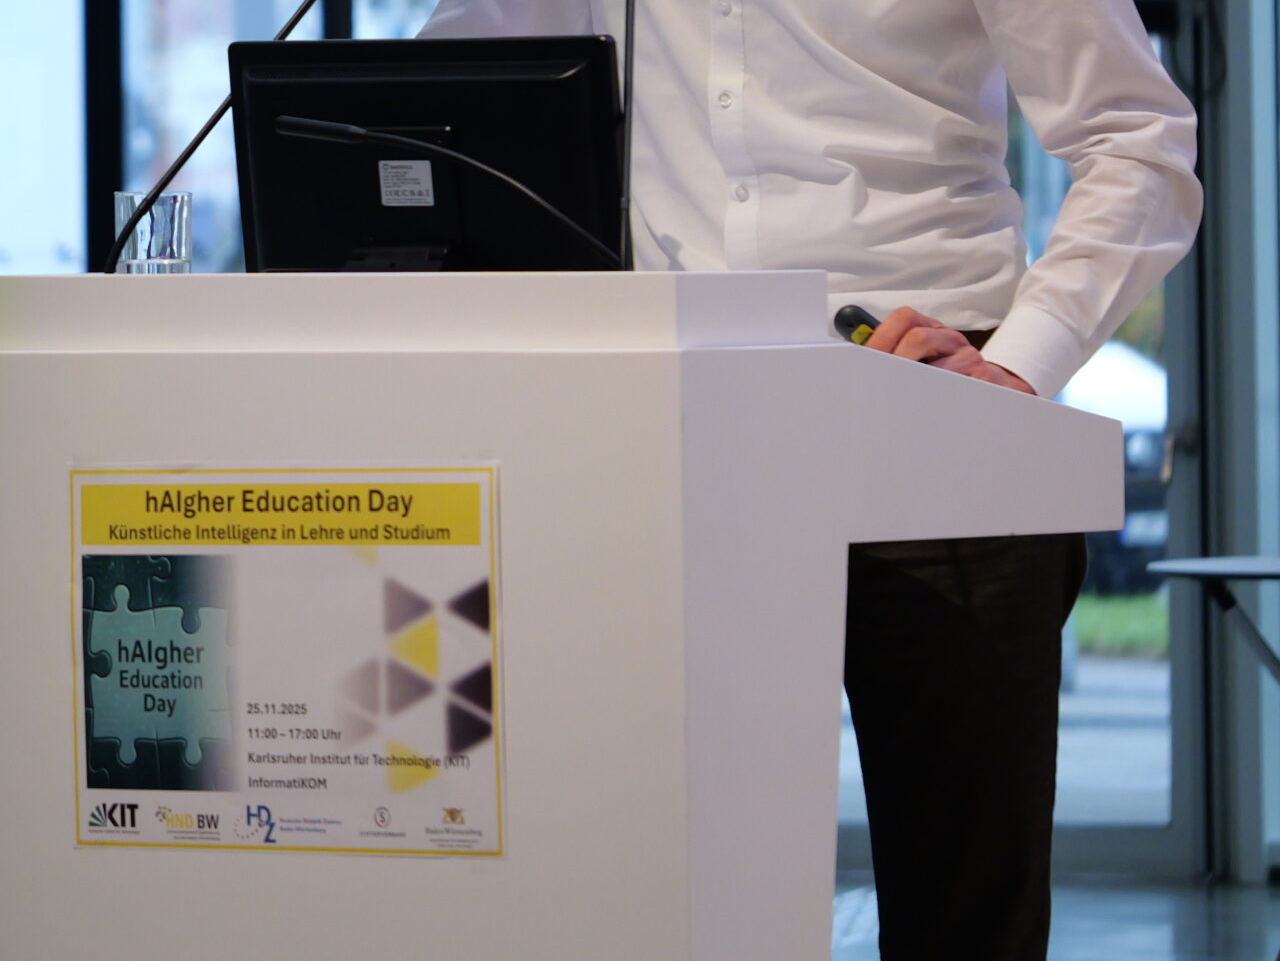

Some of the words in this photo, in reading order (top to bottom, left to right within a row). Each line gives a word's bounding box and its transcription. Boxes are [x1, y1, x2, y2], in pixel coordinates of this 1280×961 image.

[242, 489, 361, 513] Education
[368, 489, 413, 517] Day
[109, 524, 192, 540] Künstliche
[196, 524, 278, 543] Intelligenz
[281, 524, 296, 540] in
[300, 524, 345, 540] Lehre
[349, 524, 379, 540] und
[383, 524, 451, 540] Studium
[120, 669, 203, 689] Education
[143, 694, 177, 718] Day
[247, 703, 308, 715] 25.11.2025
[248, 728, 278, 739] 11:00
[289, 728, 319, 739] 17:00
[321, 729, 342, 740] Uhr
[248, 752, 307, 764] Karlsruher
[310, 753, 351, 765] Institut
[354, 754, 369, 766] für
[372, 754, 441, 769] Technologie
[444, 755, 470, 769] (KIT)
[248, 777, 328, 790] InformatiKOM
[102, 803, 139, 828] KIT
[197, 814, 219, 829] BW
